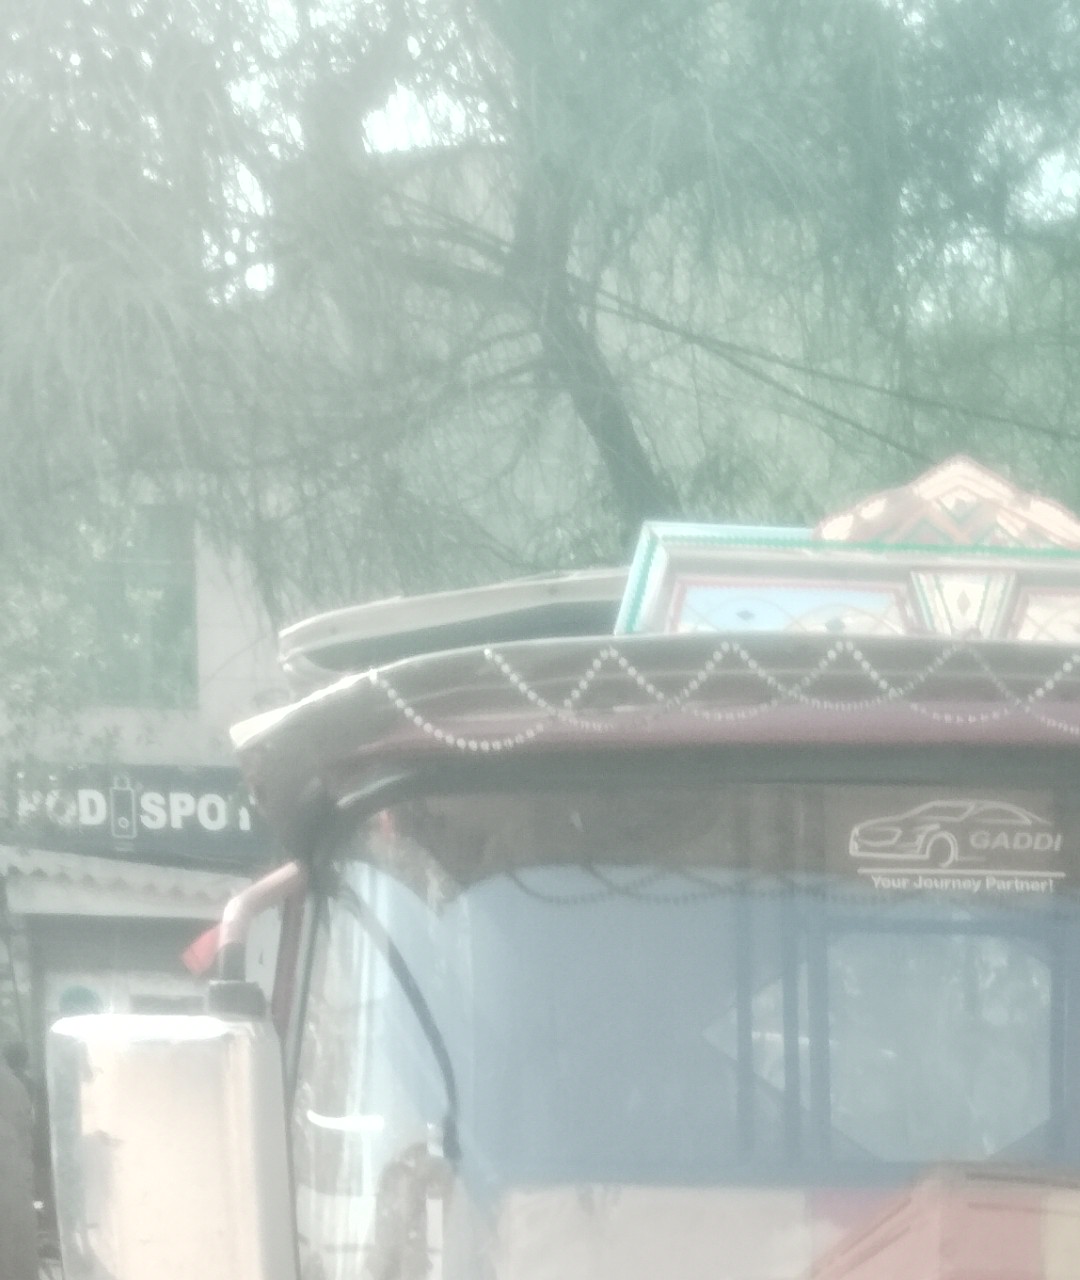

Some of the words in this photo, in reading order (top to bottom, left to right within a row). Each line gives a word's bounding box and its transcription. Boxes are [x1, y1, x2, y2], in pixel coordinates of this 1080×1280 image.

[970, 830, 1063, 852] GADDI
[871, 875, 909, 890] Your
[914, 876, 982, 894] Journey
